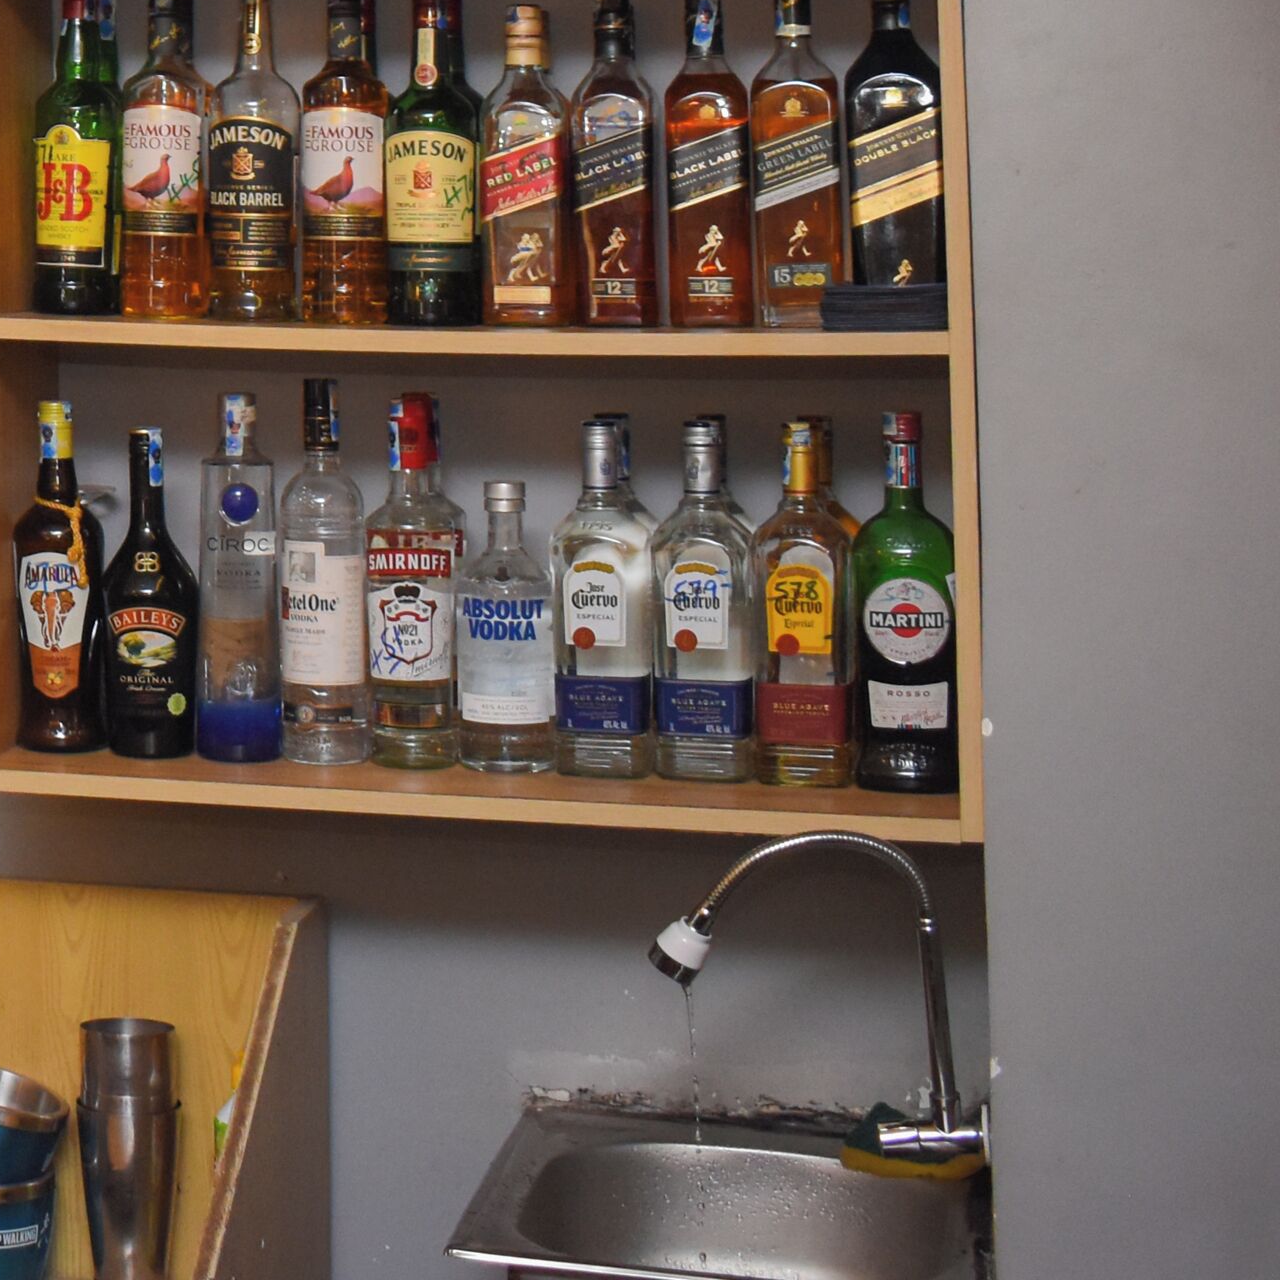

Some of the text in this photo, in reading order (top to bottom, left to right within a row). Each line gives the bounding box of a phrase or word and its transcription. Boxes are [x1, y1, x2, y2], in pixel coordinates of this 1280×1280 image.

[130, 122, 192, 137] FAMOUS
[209, 124, 286, 150] JAMESON
[312, 125, 374, 140] FAMOUS
[130, 136, 191, 151] GROUSE
[312, 139, 374, 153] GROUSE
[388, 139, 467, 163] JAMESON
[854, 128, 938, 167] DOUBLE BLACK
[757, 152, 795, 171] GREEN
[797, 139, 833, 158] LABEL
[486, 172, 513, 188] RED
[515, 156, 557, 178] LABEL
[575, 163, 611, 179] BLACK
[671, 161, 707, 180] BLACK
[709, 149, 745, 167] LABEL
[37, 162, 93, 222] J&B
[211, 191, 284, 207] BLACK BARREL
[773, 269, 791, 284] 15
[605, 281, 622, 295] 12
[703, 280, 720, 294] 12
[368, 553, 447, 571] SMIRNOFF
[308, 593, 337, 611] One
[462, 596, 544, 620] ABSOLUT
[571, 589, 618, 609] Cuervo
[114, 611, 180, 629] BAILEYS
[871, 612, 943, 628] MARTINI
[468, 619, 537, 641] VODKA
[120, 675, 175, 684] ORIGINAL
[3, 1227, 38, 1246] WALKING
